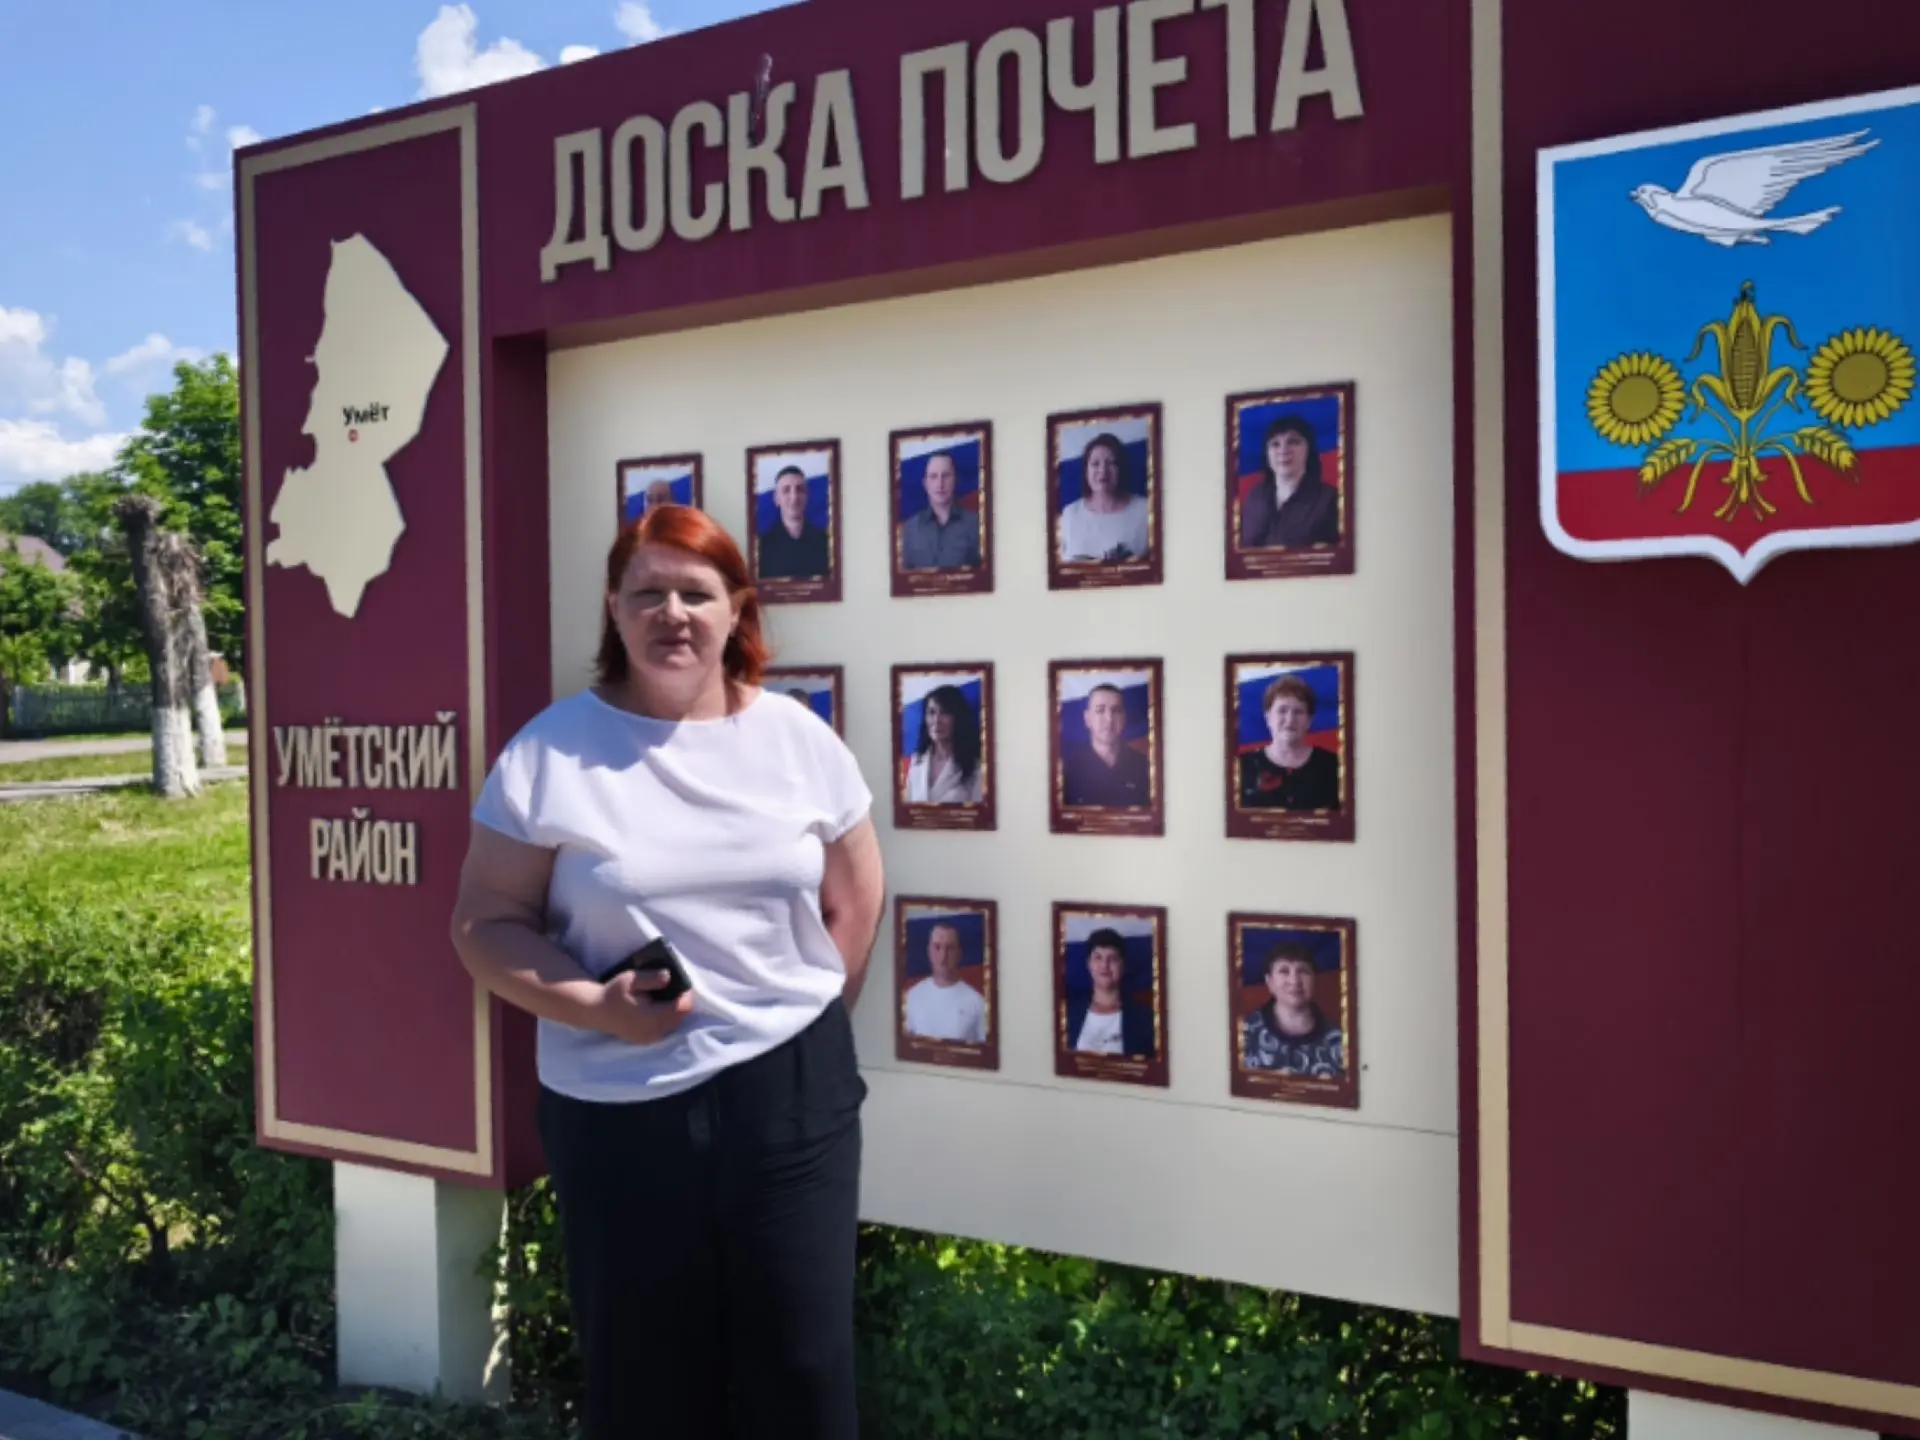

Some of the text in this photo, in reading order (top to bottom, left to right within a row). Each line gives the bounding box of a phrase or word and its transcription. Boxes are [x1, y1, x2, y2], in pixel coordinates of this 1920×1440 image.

[540, 0, 1364, 283] ДОСКА ПОЧЕТА
[342, 404, 390, 426] Умёт
[274, 712, 458, 790] УМЁТСКИЙ
[310, 808, 418, 885] РАЙОН
